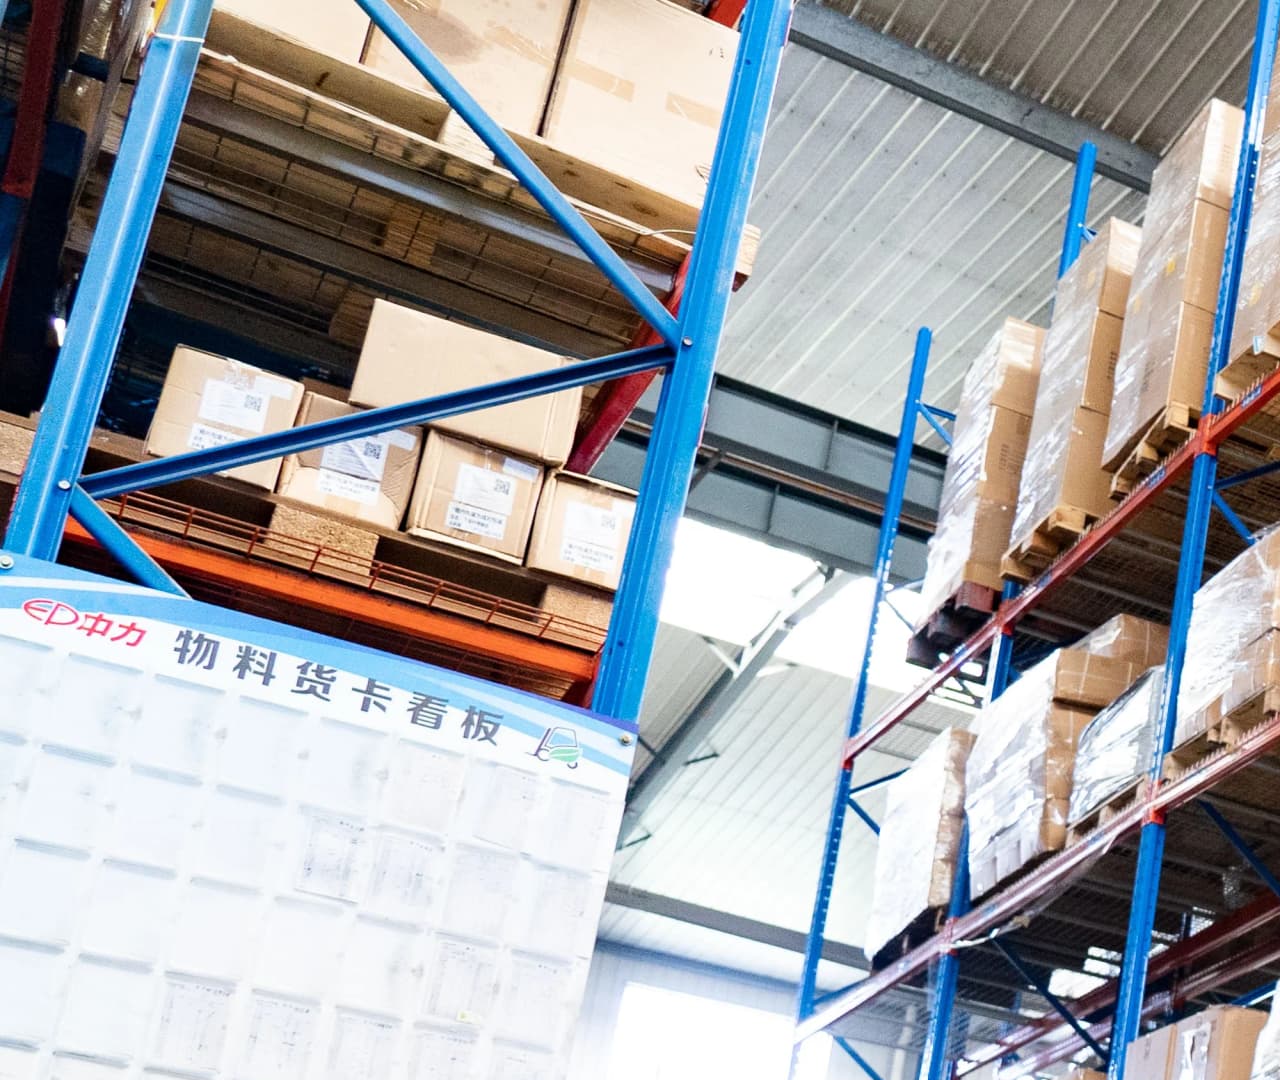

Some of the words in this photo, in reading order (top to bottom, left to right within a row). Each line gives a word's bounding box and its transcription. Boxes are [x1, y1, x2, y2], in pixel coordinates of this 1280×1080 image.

[77, 613, 147, 647] 中力
[173, 629, 504, 747] 物料货卡看板
